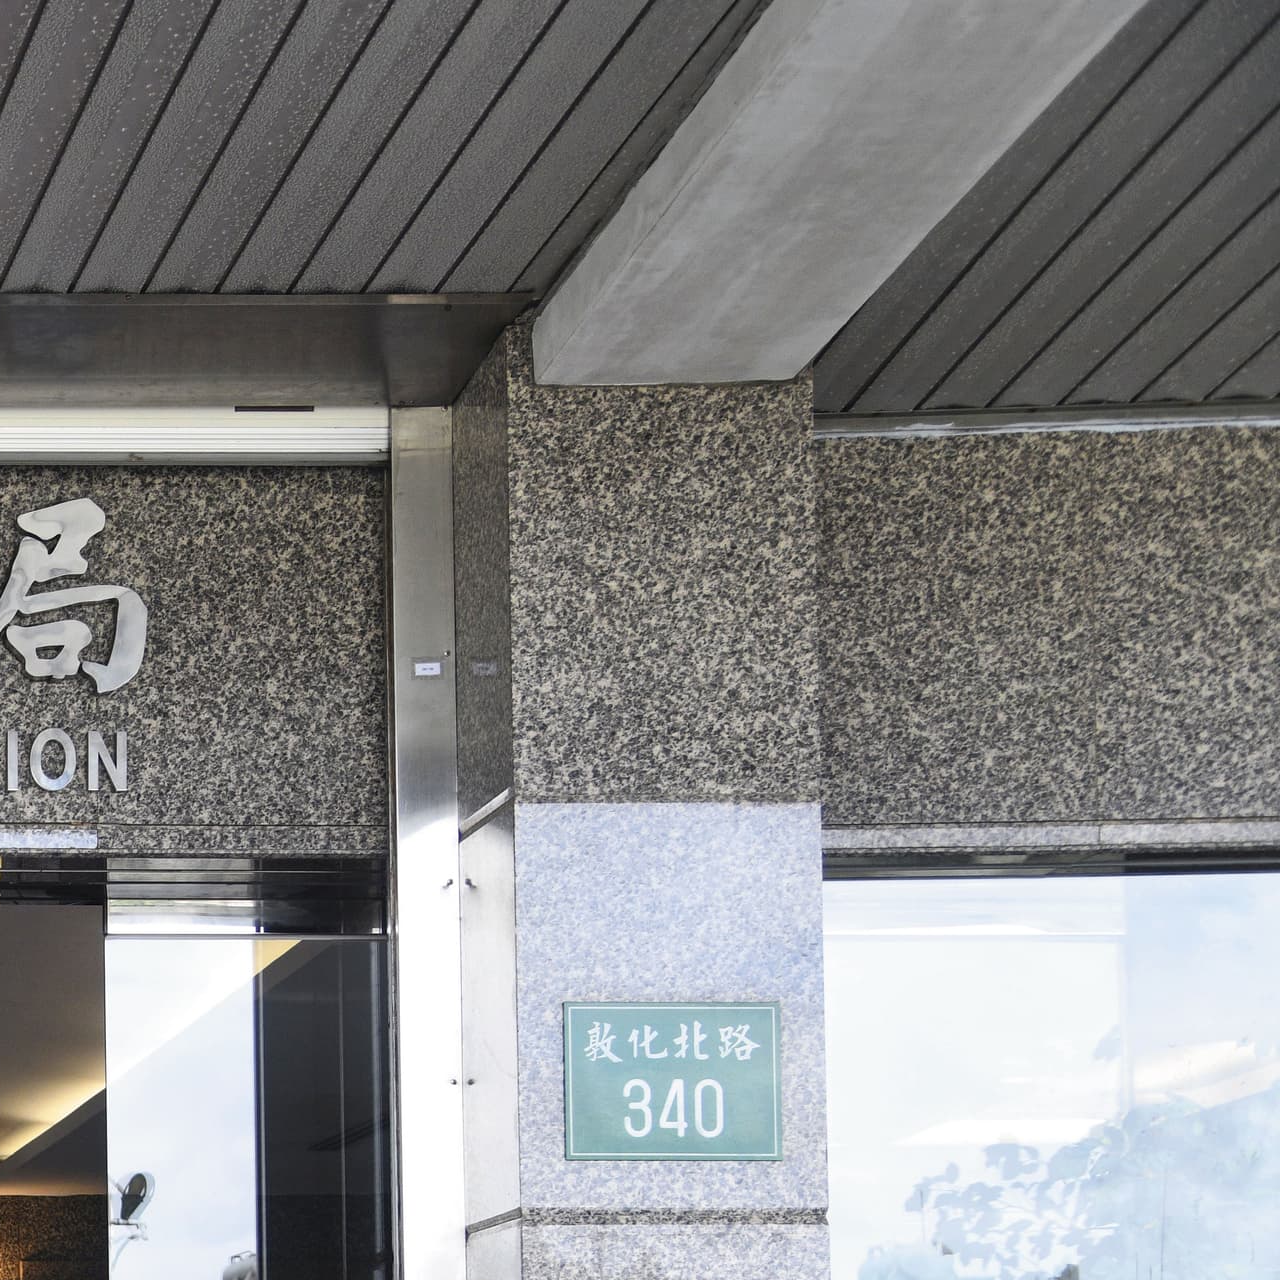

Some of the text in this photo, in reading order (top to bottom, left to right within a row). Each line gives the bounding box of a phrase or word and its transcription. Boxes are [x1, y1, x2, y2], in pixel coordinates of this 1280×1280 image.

[583, 1020, 761, 1064] 敦化北路
[623, 1078, 724, 1138] 340
